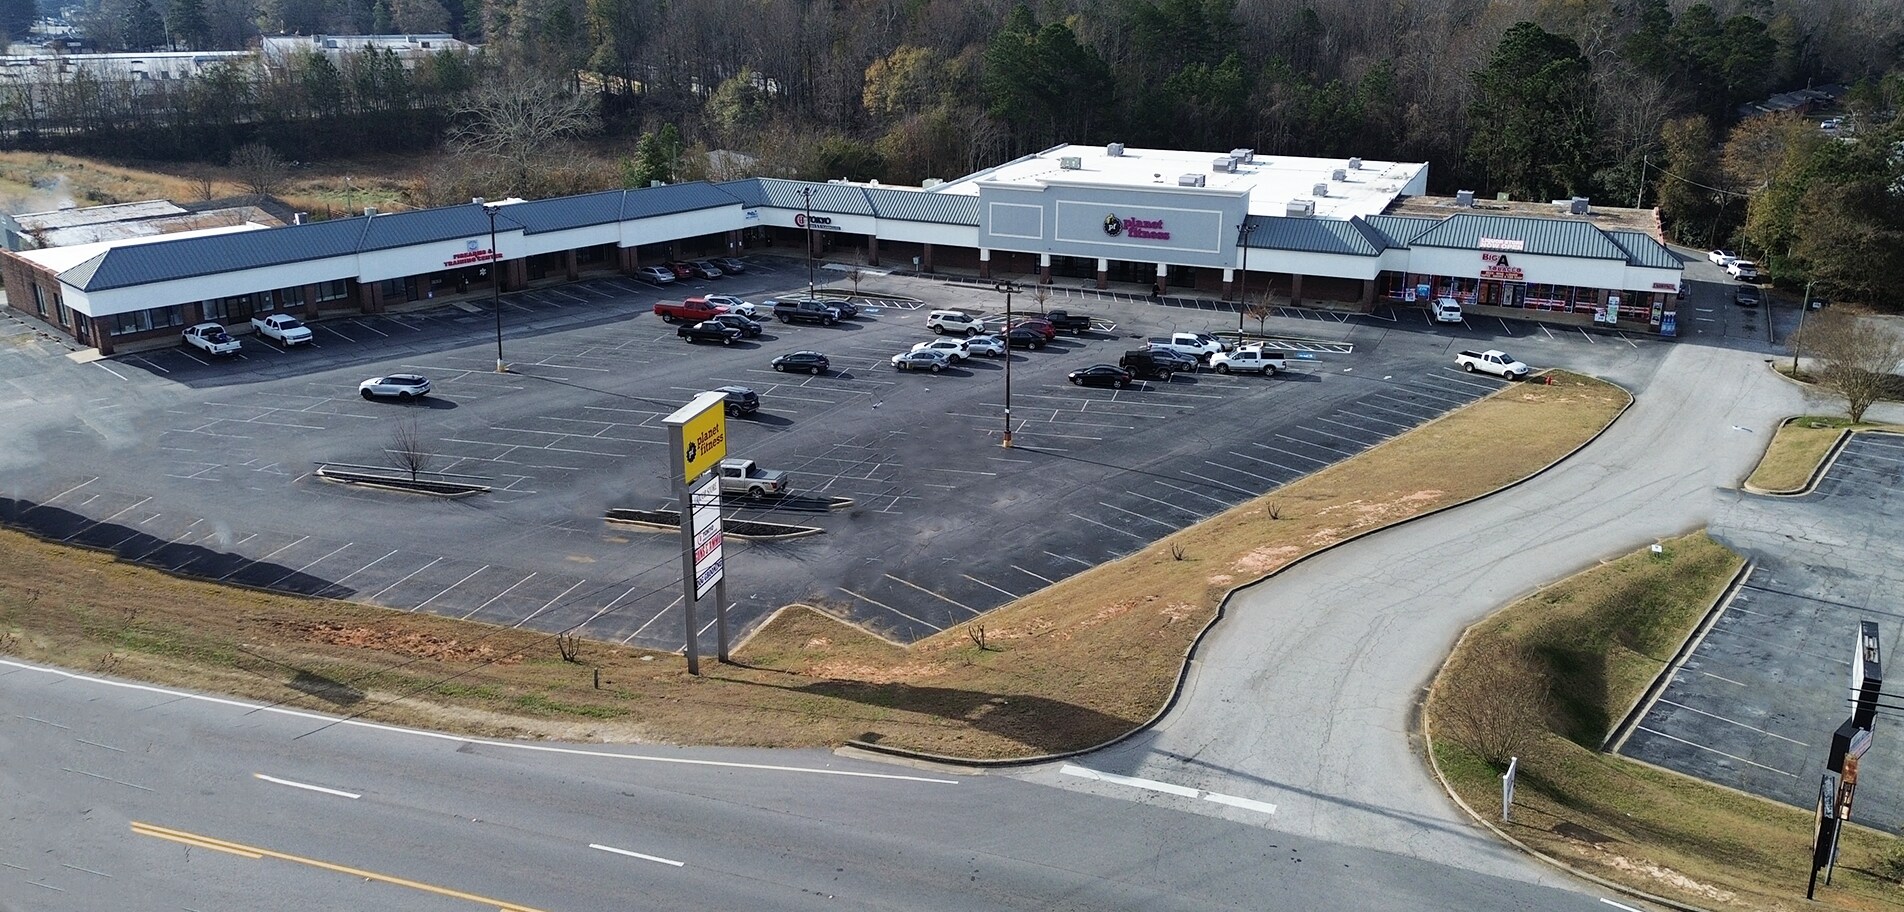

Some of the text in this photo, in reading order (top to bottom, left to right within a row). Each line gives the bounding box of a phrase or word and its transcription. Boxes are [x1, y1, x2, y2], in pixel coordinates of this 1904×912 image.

[1123, 217, 1163, 230] planet
[1128, 227, 1170, 240] fitness
[443, 253, 503, 267] TRAINING CENTER
[453, 249, 486, 259] FIREARMS
[1482, 253, 1509, 267] BIG A
[697, 423, 719, 450] planet
[700, 433, 724, 456] fitness
